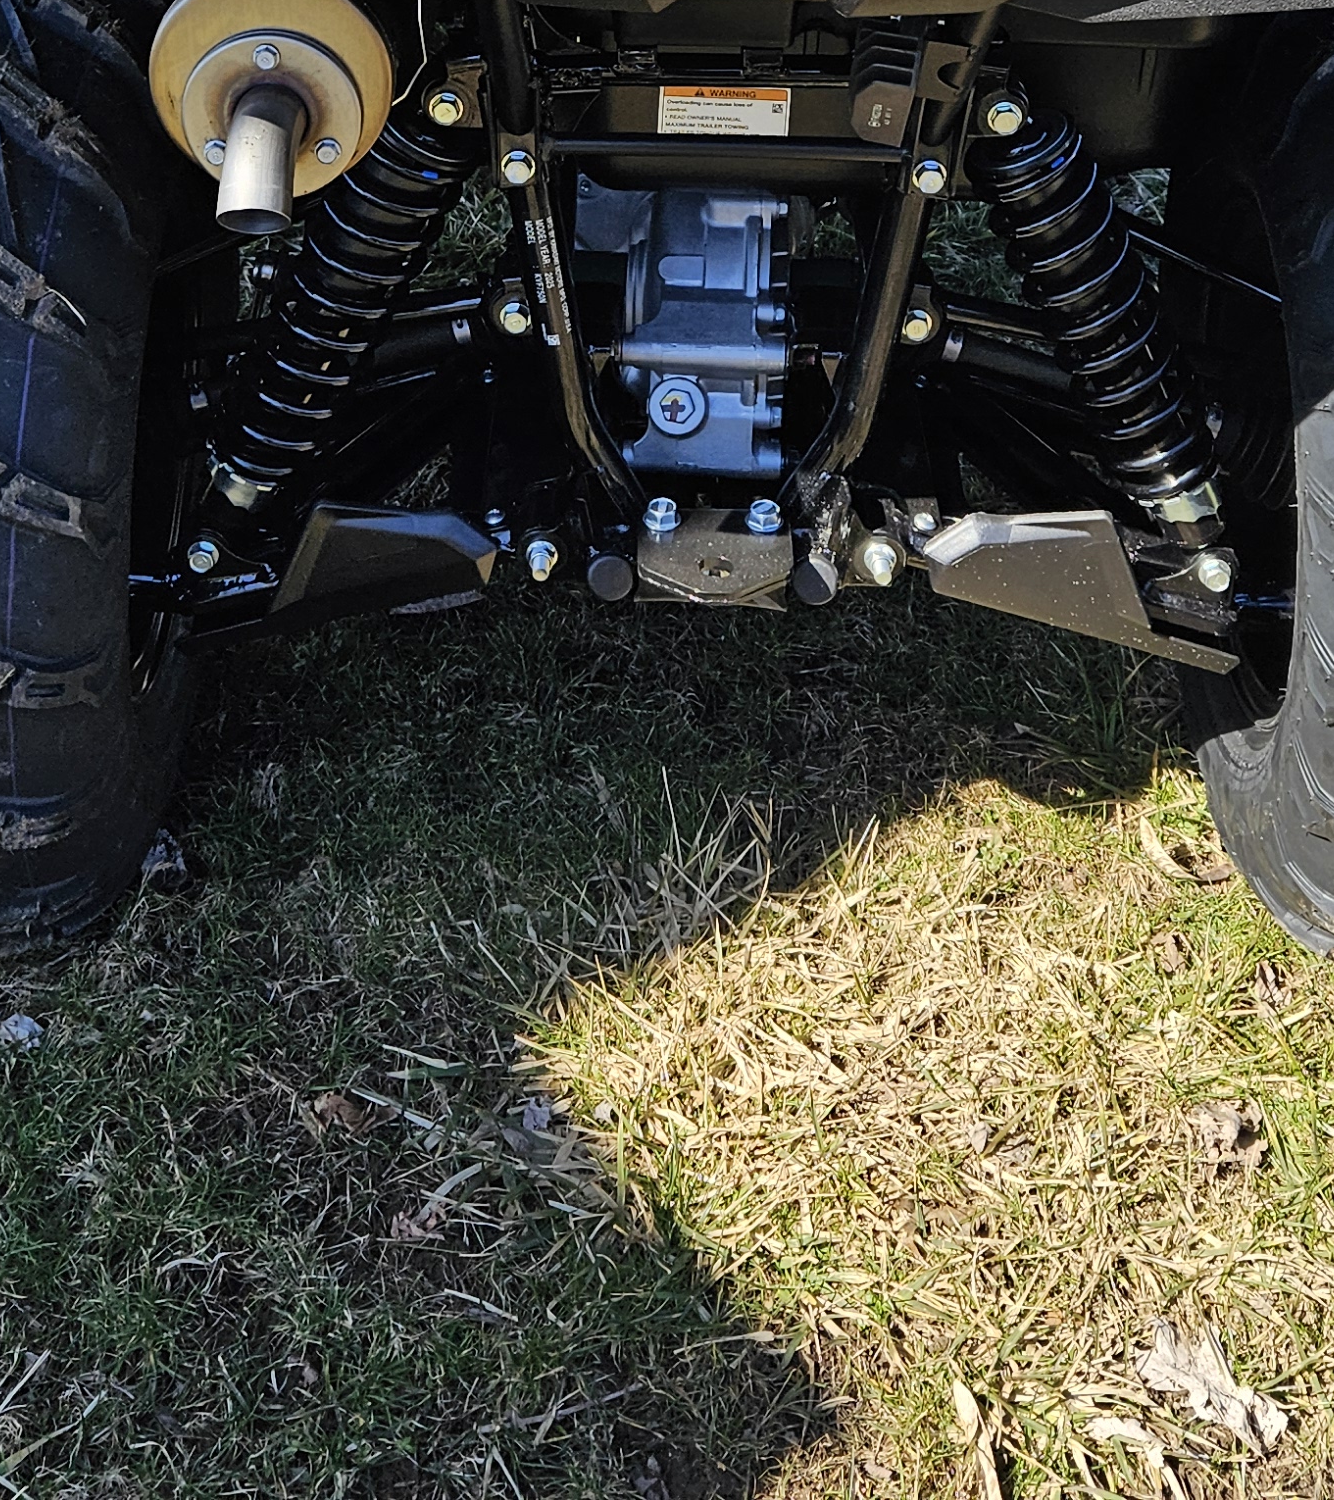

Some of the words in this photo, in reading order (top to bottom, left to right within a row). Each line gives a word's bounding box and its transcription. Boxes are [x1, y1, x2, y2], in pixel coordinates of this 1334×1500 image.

[709, 89, 757, 98] WARNING
[524, 220, 537, 245] MODEL
[535, 219, 548, 245] MODEL
[544, 272, 555, 289] 2025
